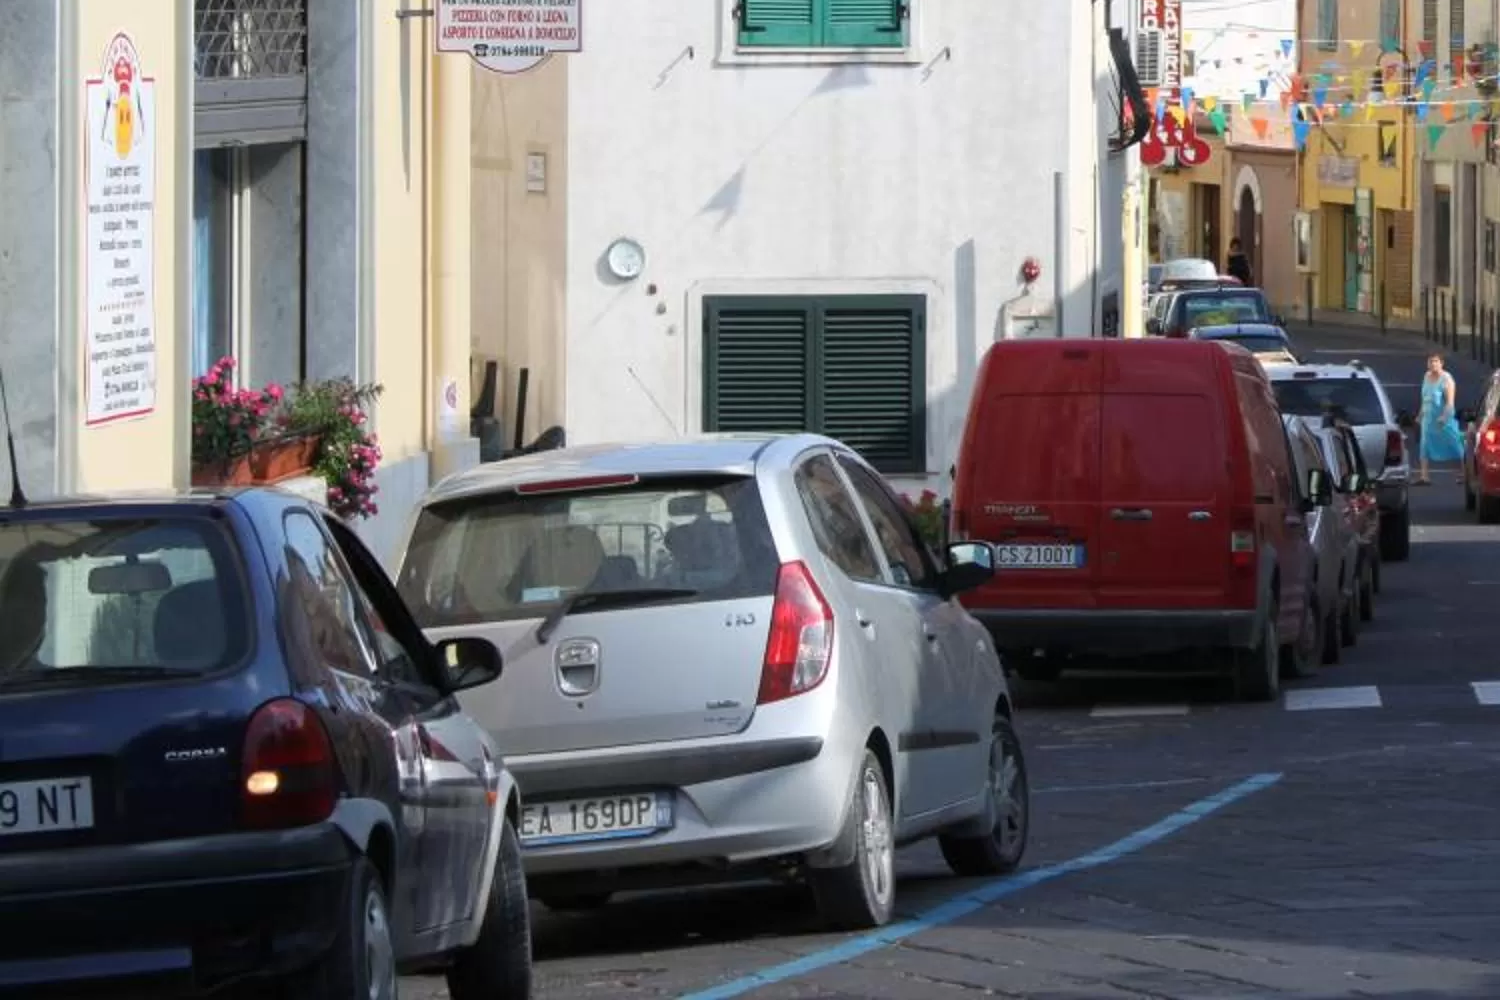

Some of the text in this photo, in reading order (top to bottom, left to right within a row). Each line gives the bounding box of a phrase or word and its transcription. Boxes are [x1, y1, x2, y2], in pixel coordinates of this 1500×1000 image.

[451, 9, 488, 22] PIZZERIA
[489, 9, 505, 22] CON
[507, 10, 534, 23] FORNO
[543, 10, 569, 23] LEGNA
[442, 25, 477, 40] ASPORTO
[486, 26, 525, 40] CONSEGNA
[535, 26, 576, 41] DOMICILIO
[1000, 546, 1018, 563] CS
[36, 783, 82, 825] NT
[520, 796, 651, 835] EA 169DP
